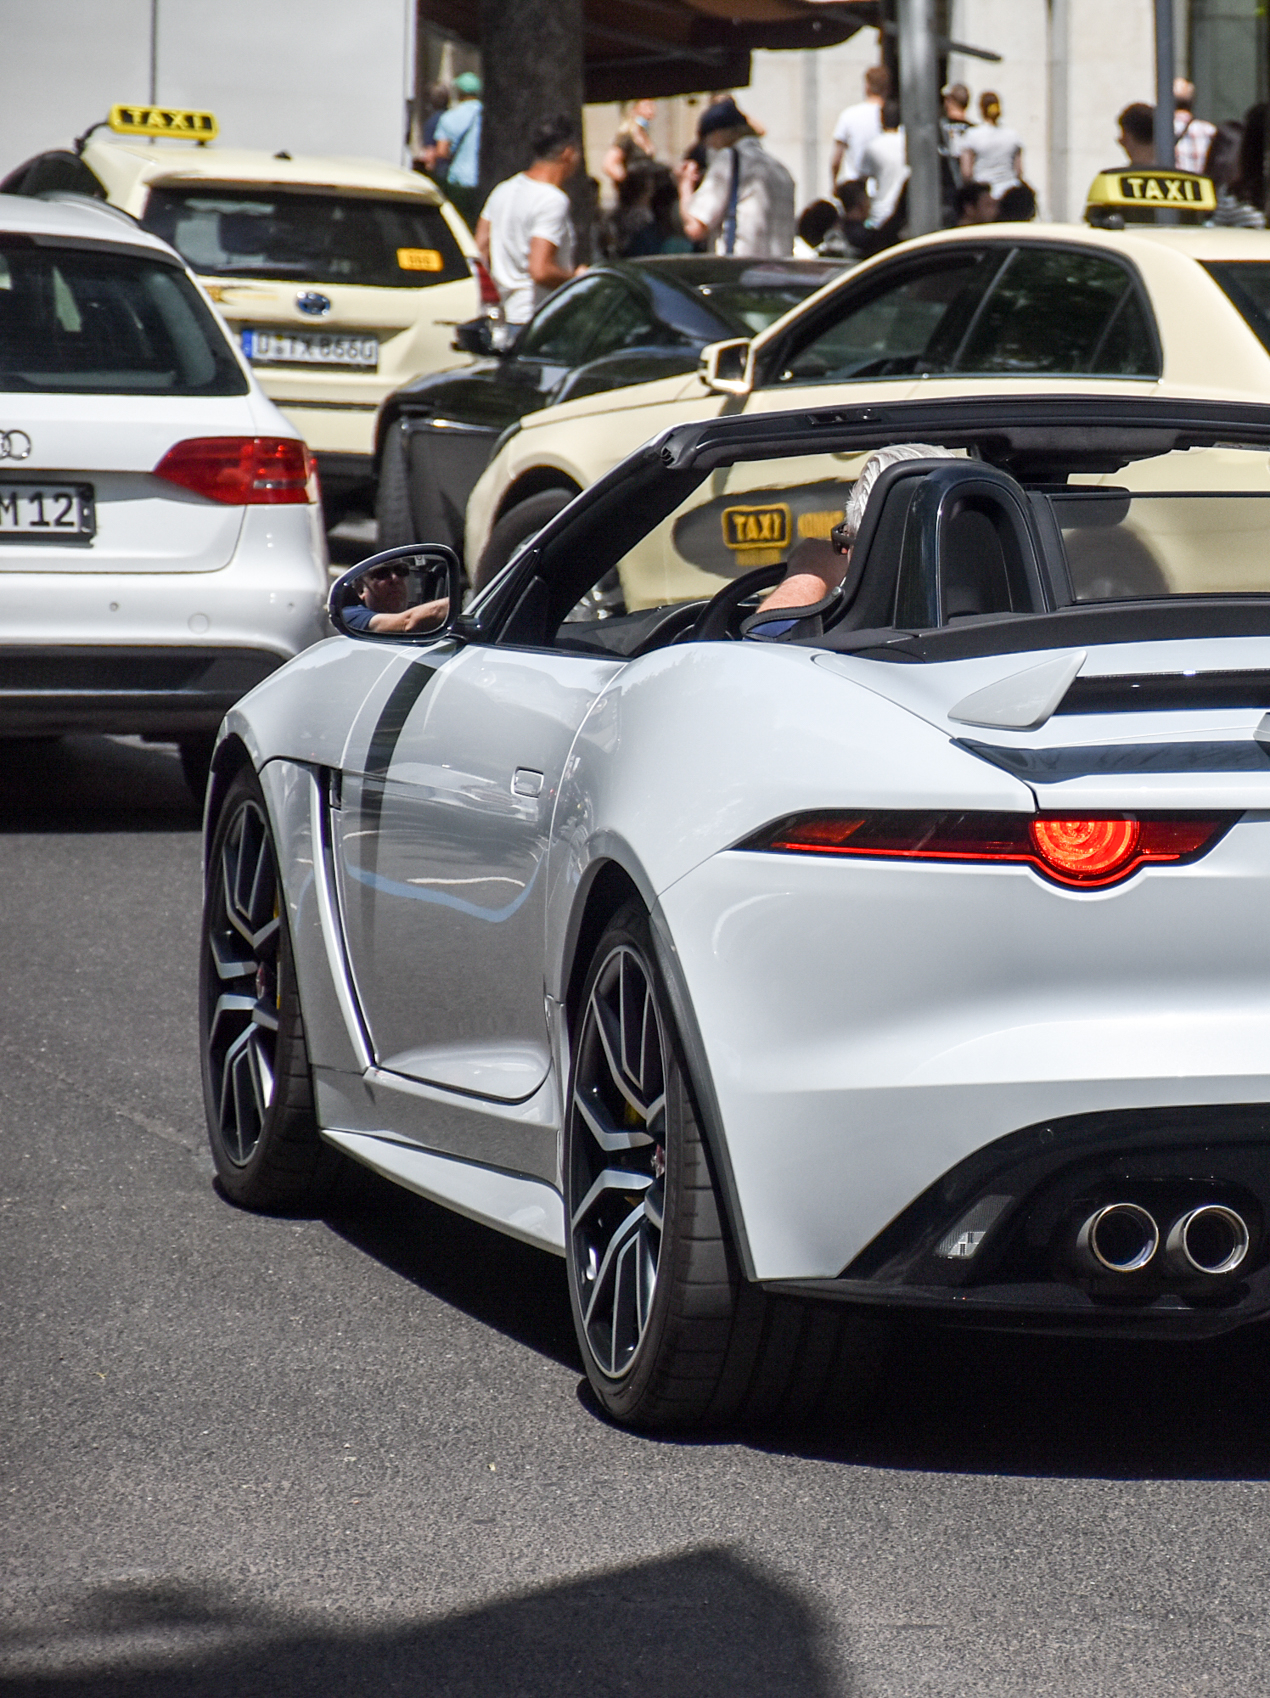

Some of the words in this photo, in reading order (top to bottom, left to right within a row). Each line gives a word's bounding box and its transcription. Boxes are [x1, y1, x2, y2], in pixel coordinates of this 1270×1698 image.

[125, 109, 202, 130] TAXI
[1127, 178, 1194, 200] TAXI
[0, 491, 18, 526] M
[28, 491, 75, 526] 12
[732, 511, 782, 541] TAXI
